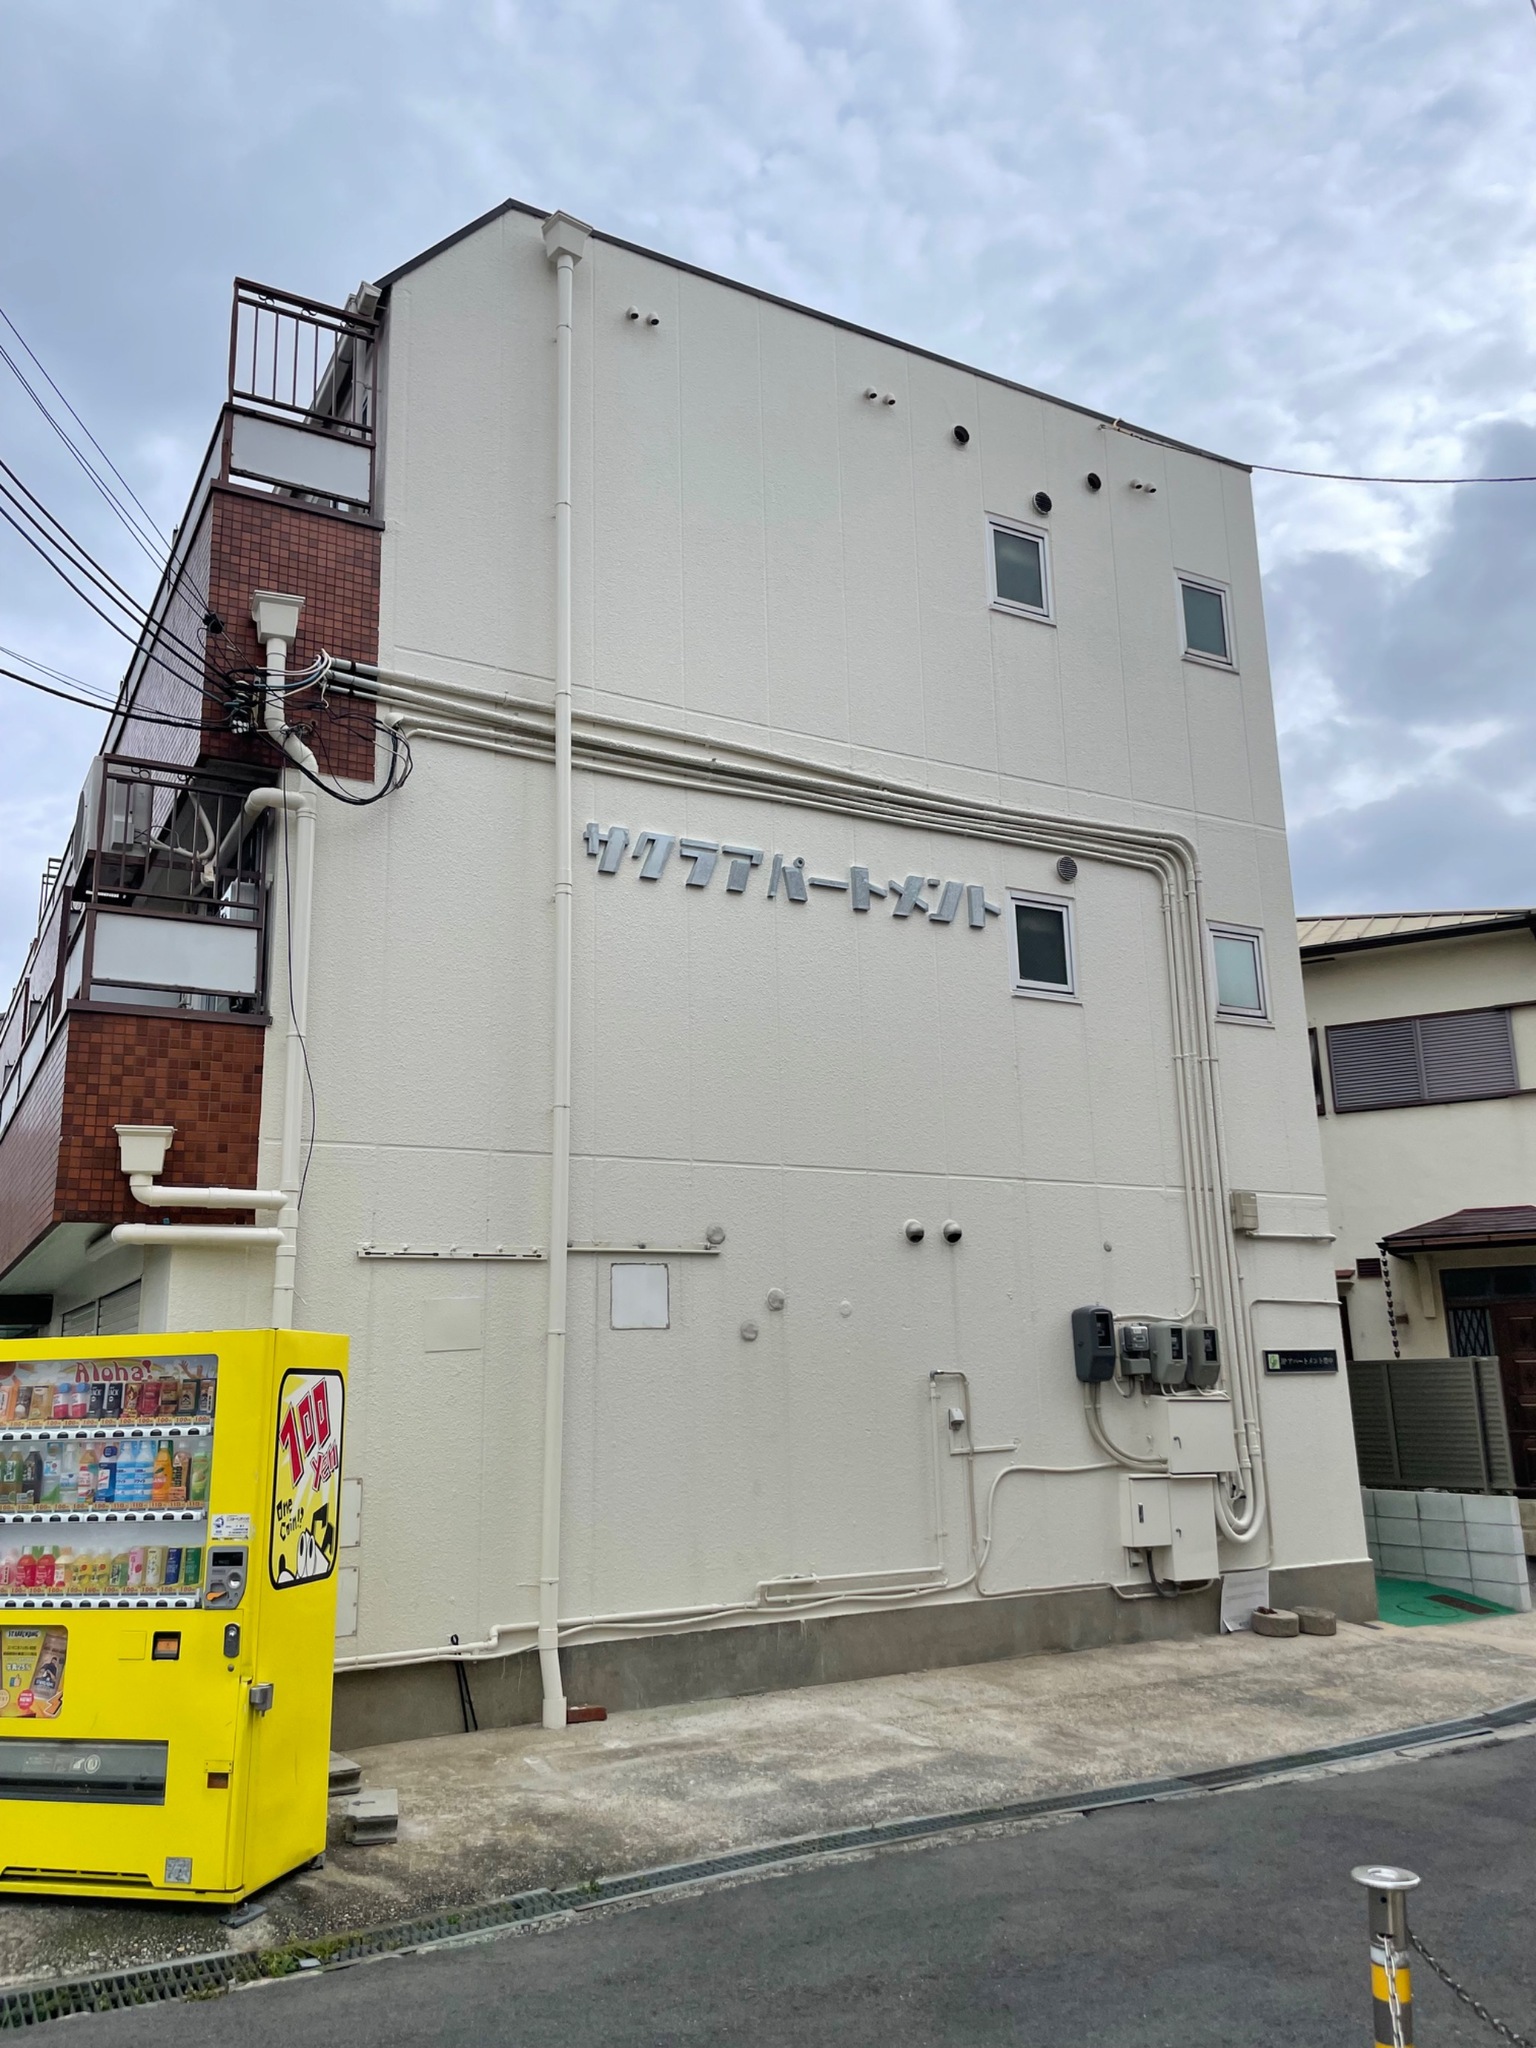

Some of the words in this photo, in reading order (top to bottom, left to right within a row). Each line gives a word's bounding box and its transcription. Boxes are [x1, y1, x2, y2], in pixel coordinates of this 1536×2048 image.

[583, 822, 1001, 928] サクラアパートメント
[75, 1359, 153, 1383] Aloha!
[279, 1377, 331, 1489] 100
[276, 1498, 293, 1522] One
